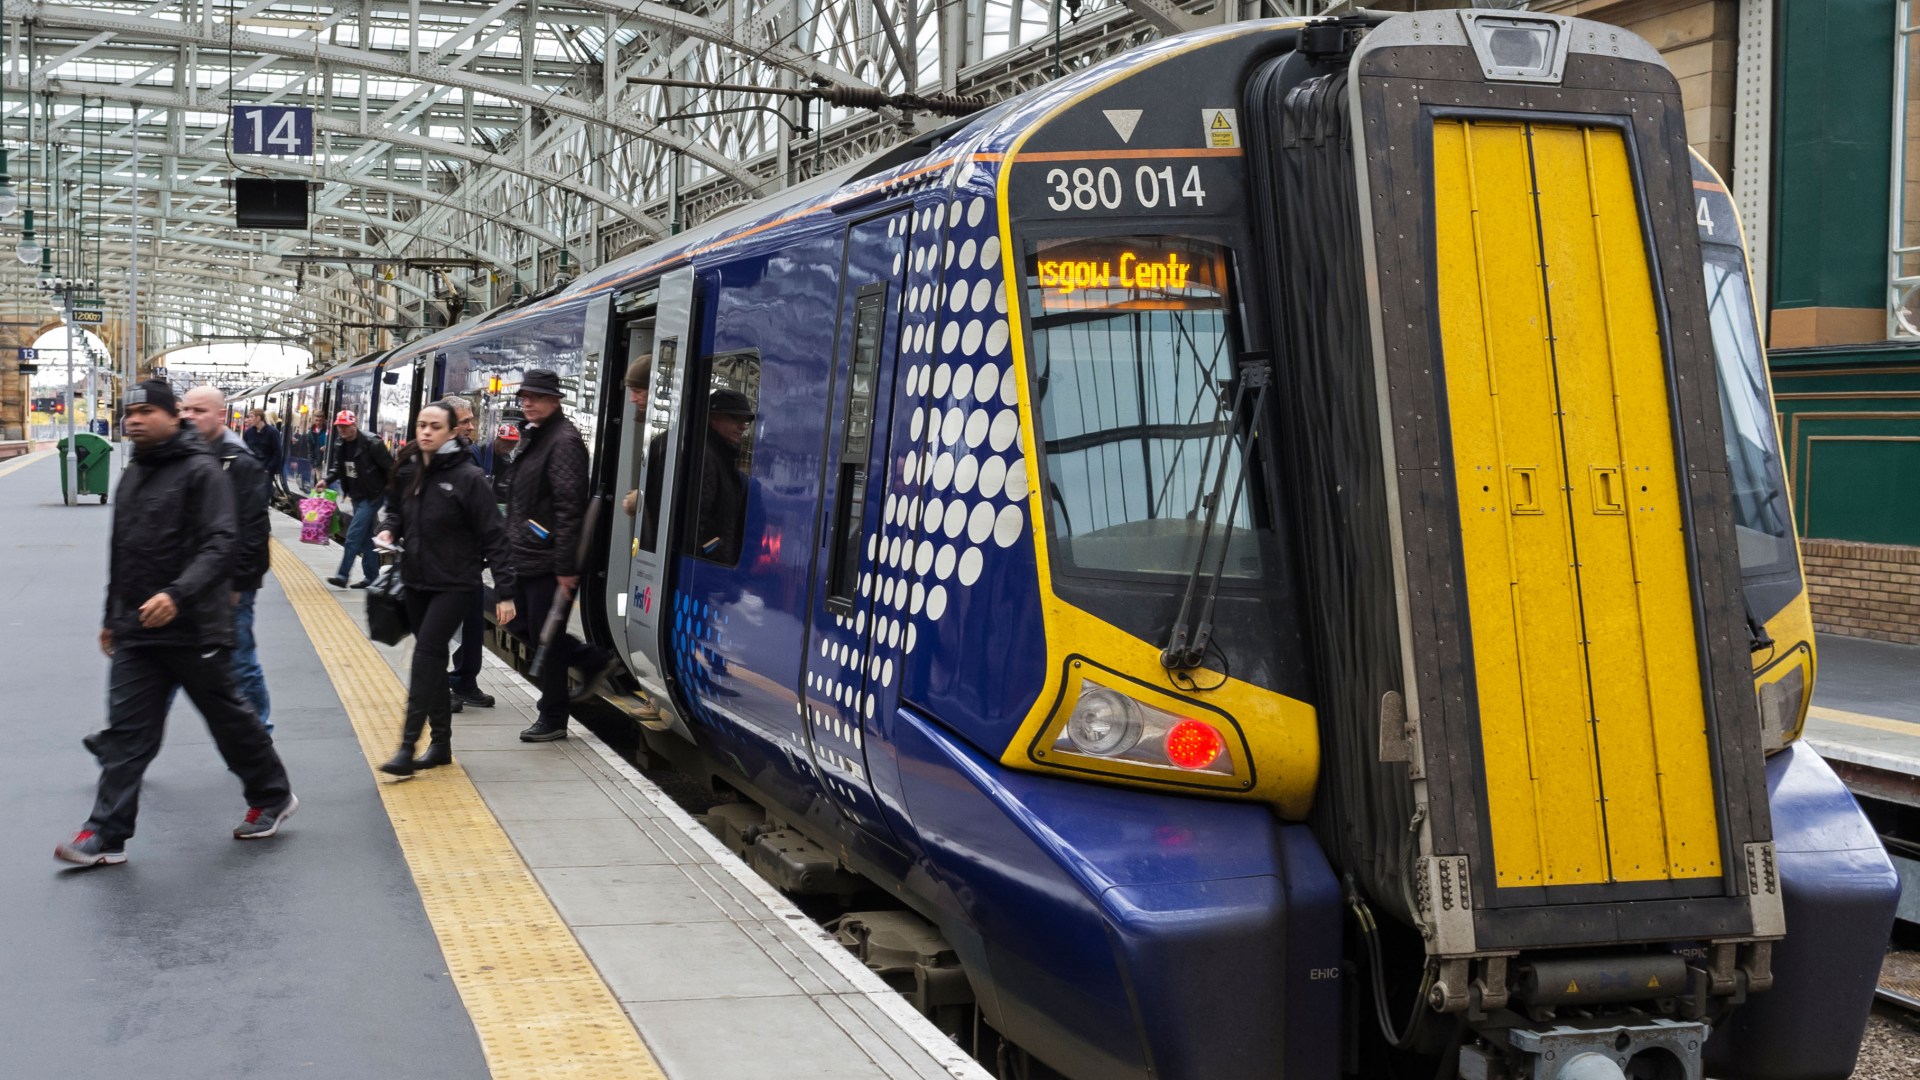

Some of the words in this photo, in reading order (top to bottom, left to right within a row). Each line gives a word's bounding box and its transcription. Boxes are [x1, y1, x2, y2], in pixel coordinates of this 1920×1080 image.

[245, 109, 301, 153] 14
[1046, 166, 1122, 211] 380
[1135, 165, 1206, 208] 014
[1120, 252, 1190, 288] Centr
[23, 349, 35, 360] 13
[156, 367, 167, 375] 14
[1310, 967, 1339, 980] EHIC
